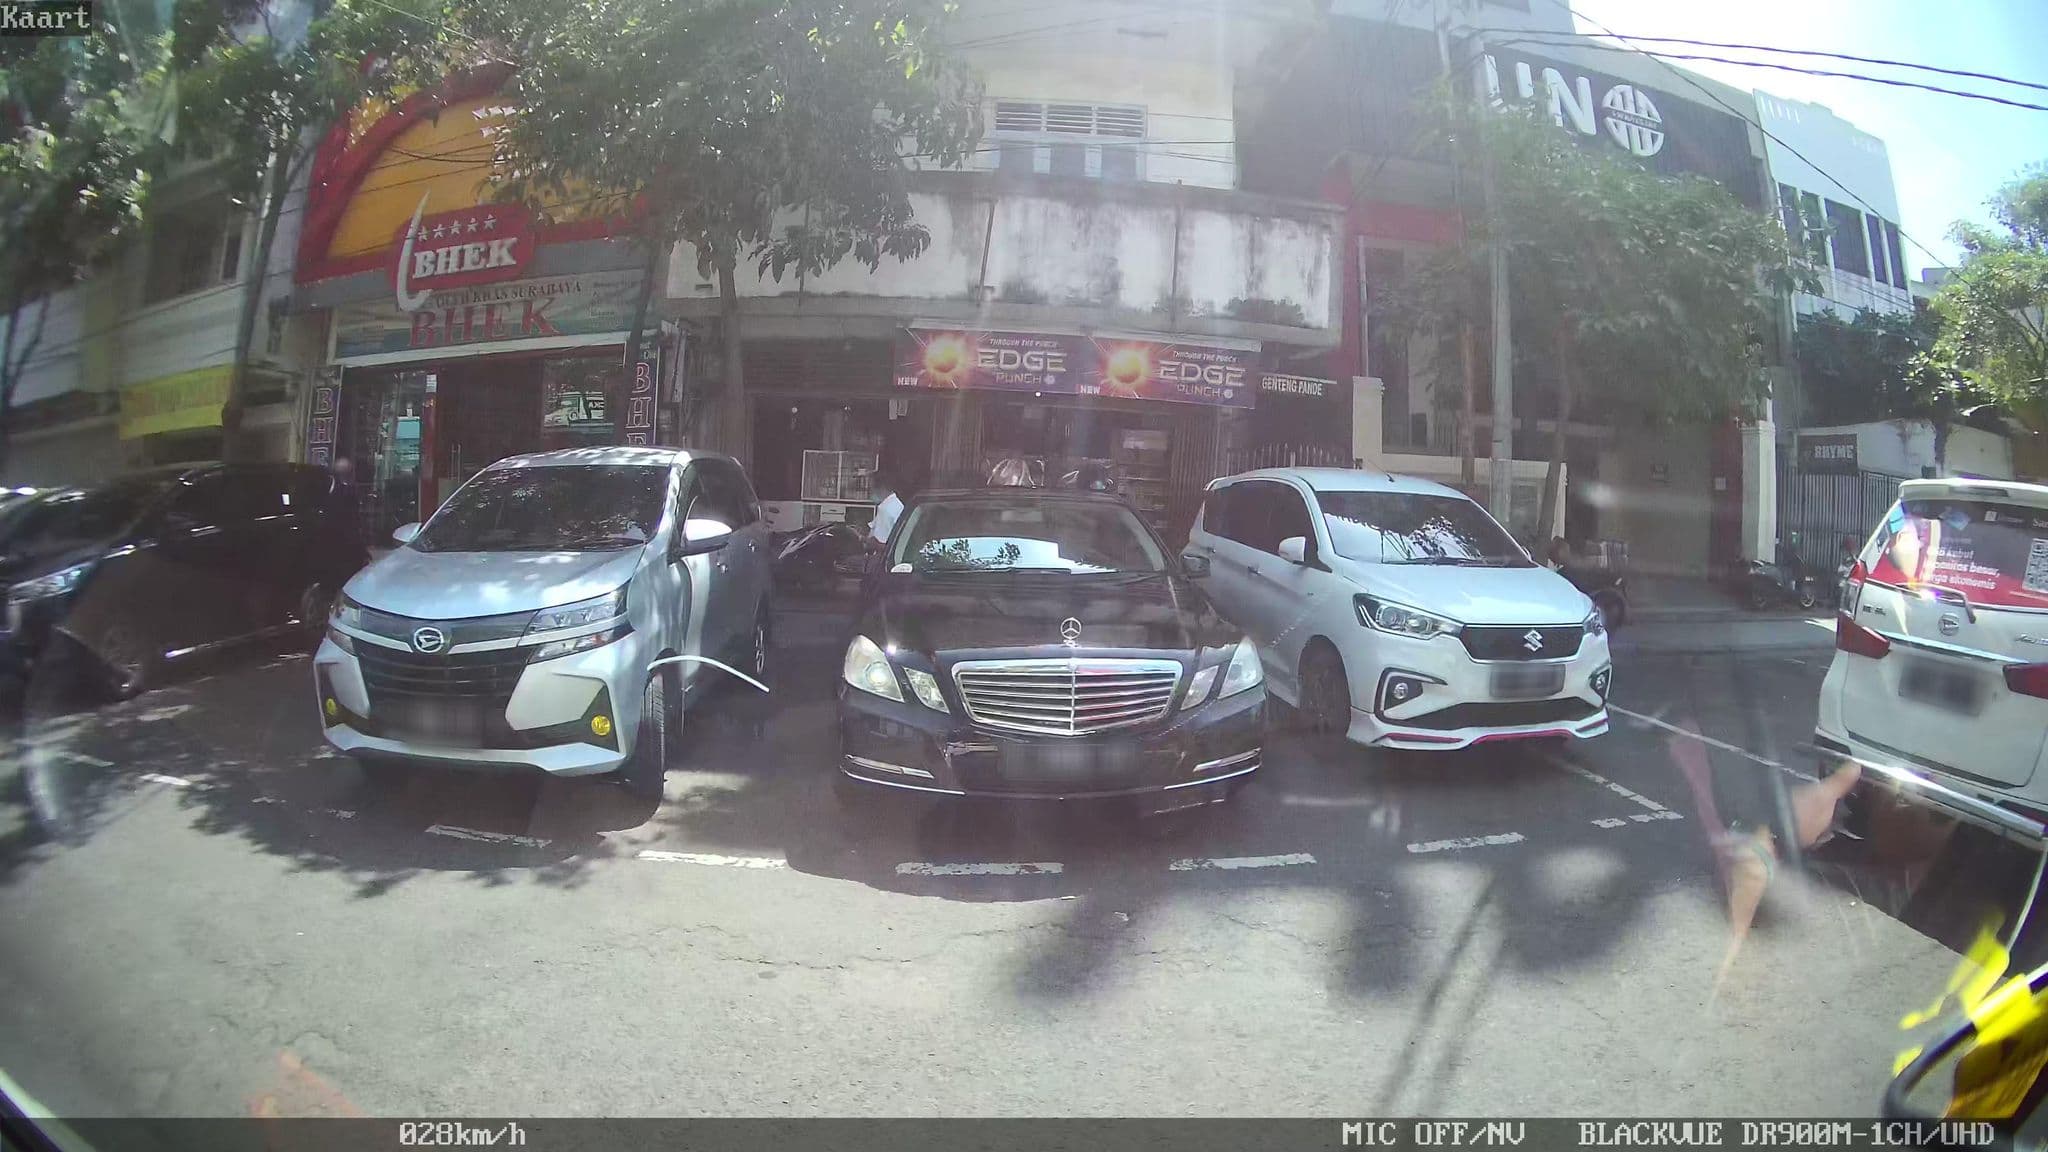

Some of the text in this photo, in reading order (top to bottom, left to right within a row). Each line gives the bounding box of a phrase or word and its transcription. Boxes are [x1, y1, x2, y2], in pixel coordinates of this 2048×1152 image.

[412, 237, 517, 280] BHEK
[409, 296, 564, 347] BHEK
[976, 348, 1067, 373] EDGE
[897, 376, 919, 387] NEW
[995, 371, 1042, 385] PUNCH
[1158, 359, 1247, 387] EDGE
[1079, 385, 1101, 395] NEW
[1262, 375, 1323, 396] GENTENG PANDE
[1814, 444, 1854, 459] RHYME
